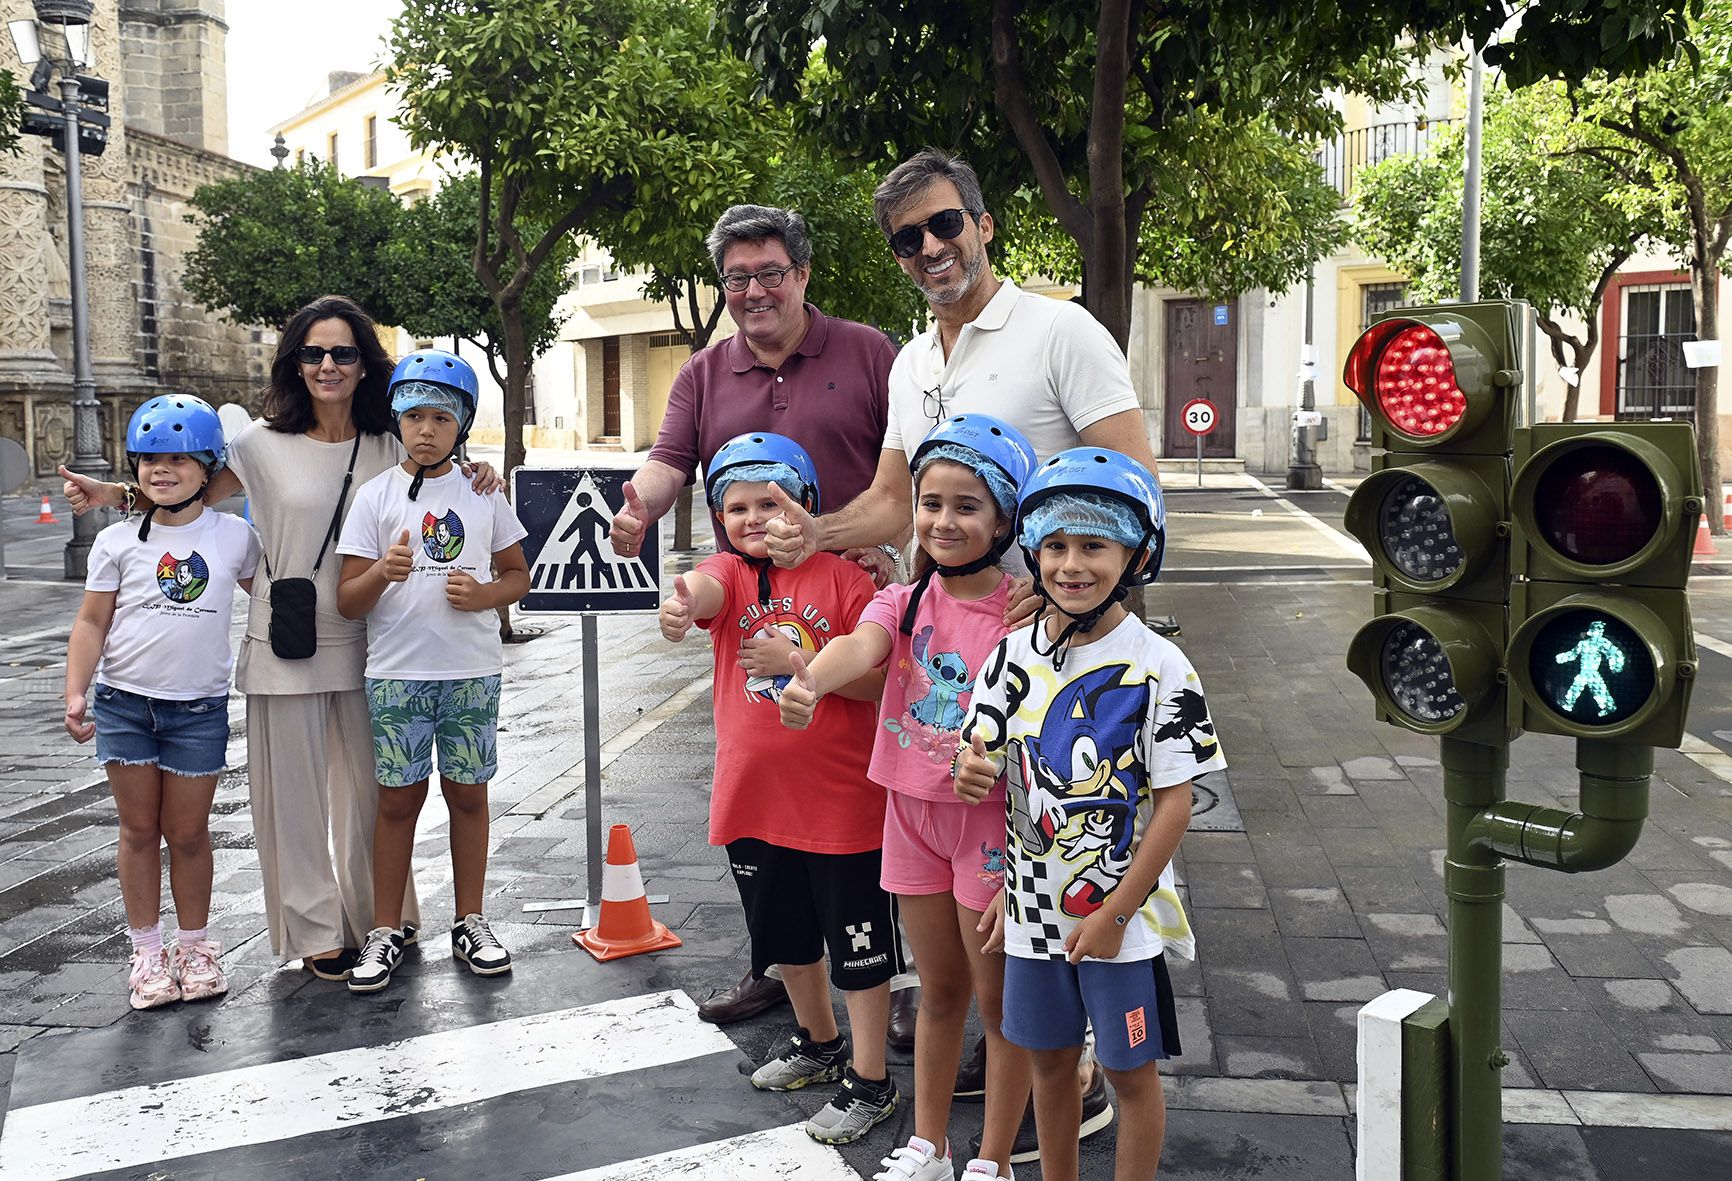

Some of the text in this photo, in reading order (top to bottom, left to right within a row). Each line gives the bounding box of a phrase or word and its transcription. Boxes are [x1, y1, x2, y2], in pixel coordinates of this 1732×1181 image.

[1189, 411, 1210, 423] 30
[964, 430, 980, 438] DGT
[164, 604, 185, 612] Miguel
[801, 603, 831, 633] UP
[843, 953, 887, 968] MINECRAFT
[1132, 1029, 1144, 1041] 10
[968, 1167, 987, 1175] adidas
